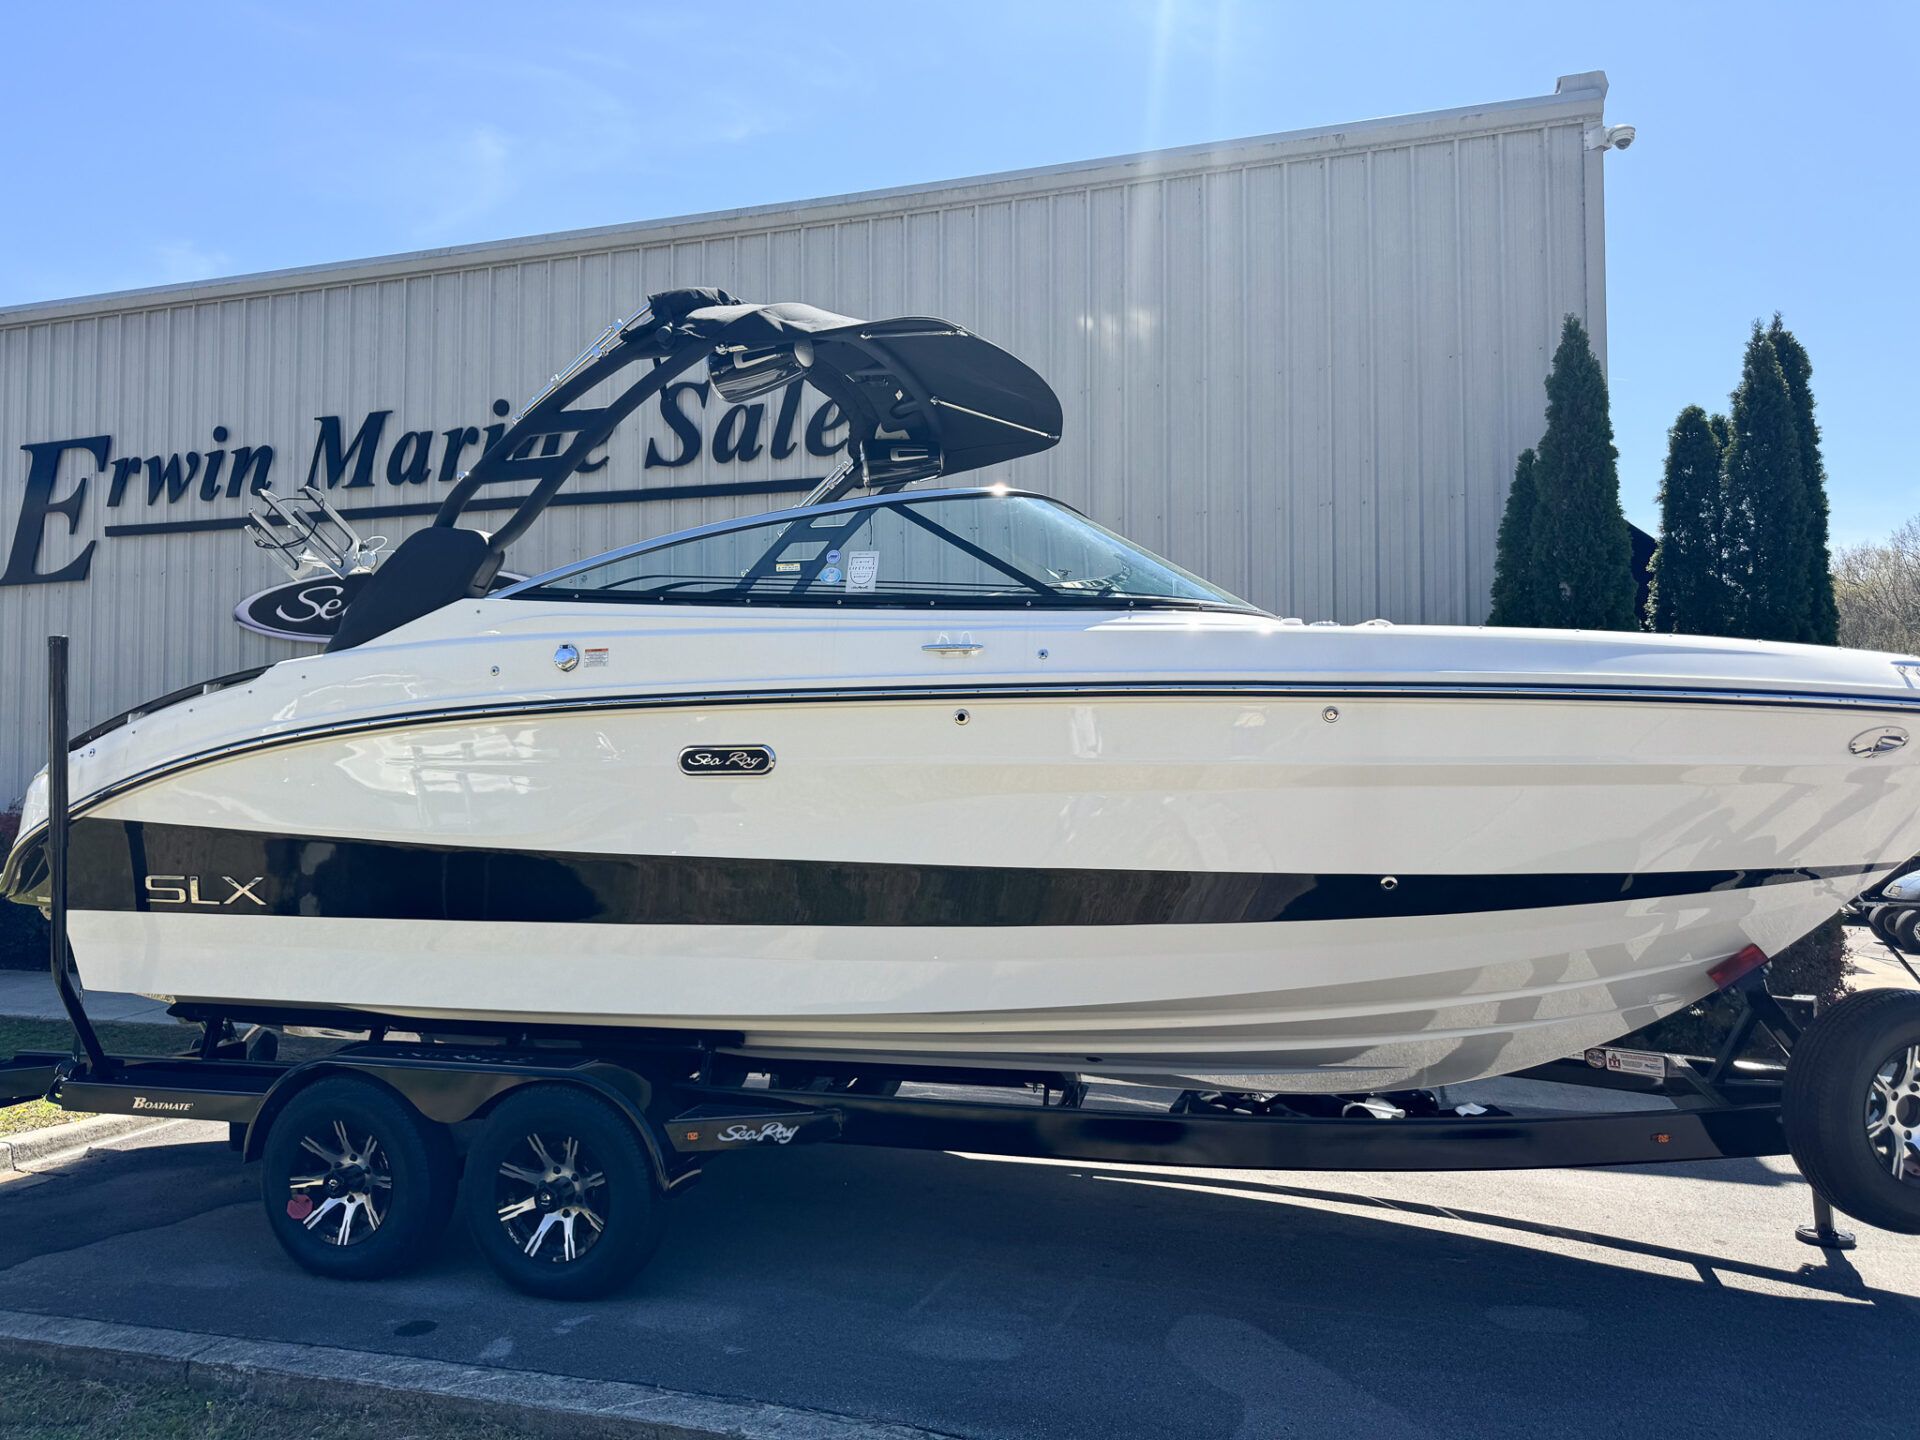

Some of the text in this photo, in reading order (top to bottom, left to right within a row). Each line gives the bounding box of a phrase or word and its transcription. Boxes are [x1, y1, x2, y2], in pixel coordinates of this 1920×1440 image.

[0, 426, 272, 586] Erwin
[645, 379, 849, 469] Sale
[276, 585, 347, 623] Se
[687, 751, 763, 769] Sea Ray
[145, 874, 267, 905] SLX
[132, 1096, 190, 1111] BOATMATE
[717, 1121, 799, 1144] Sea Ray
